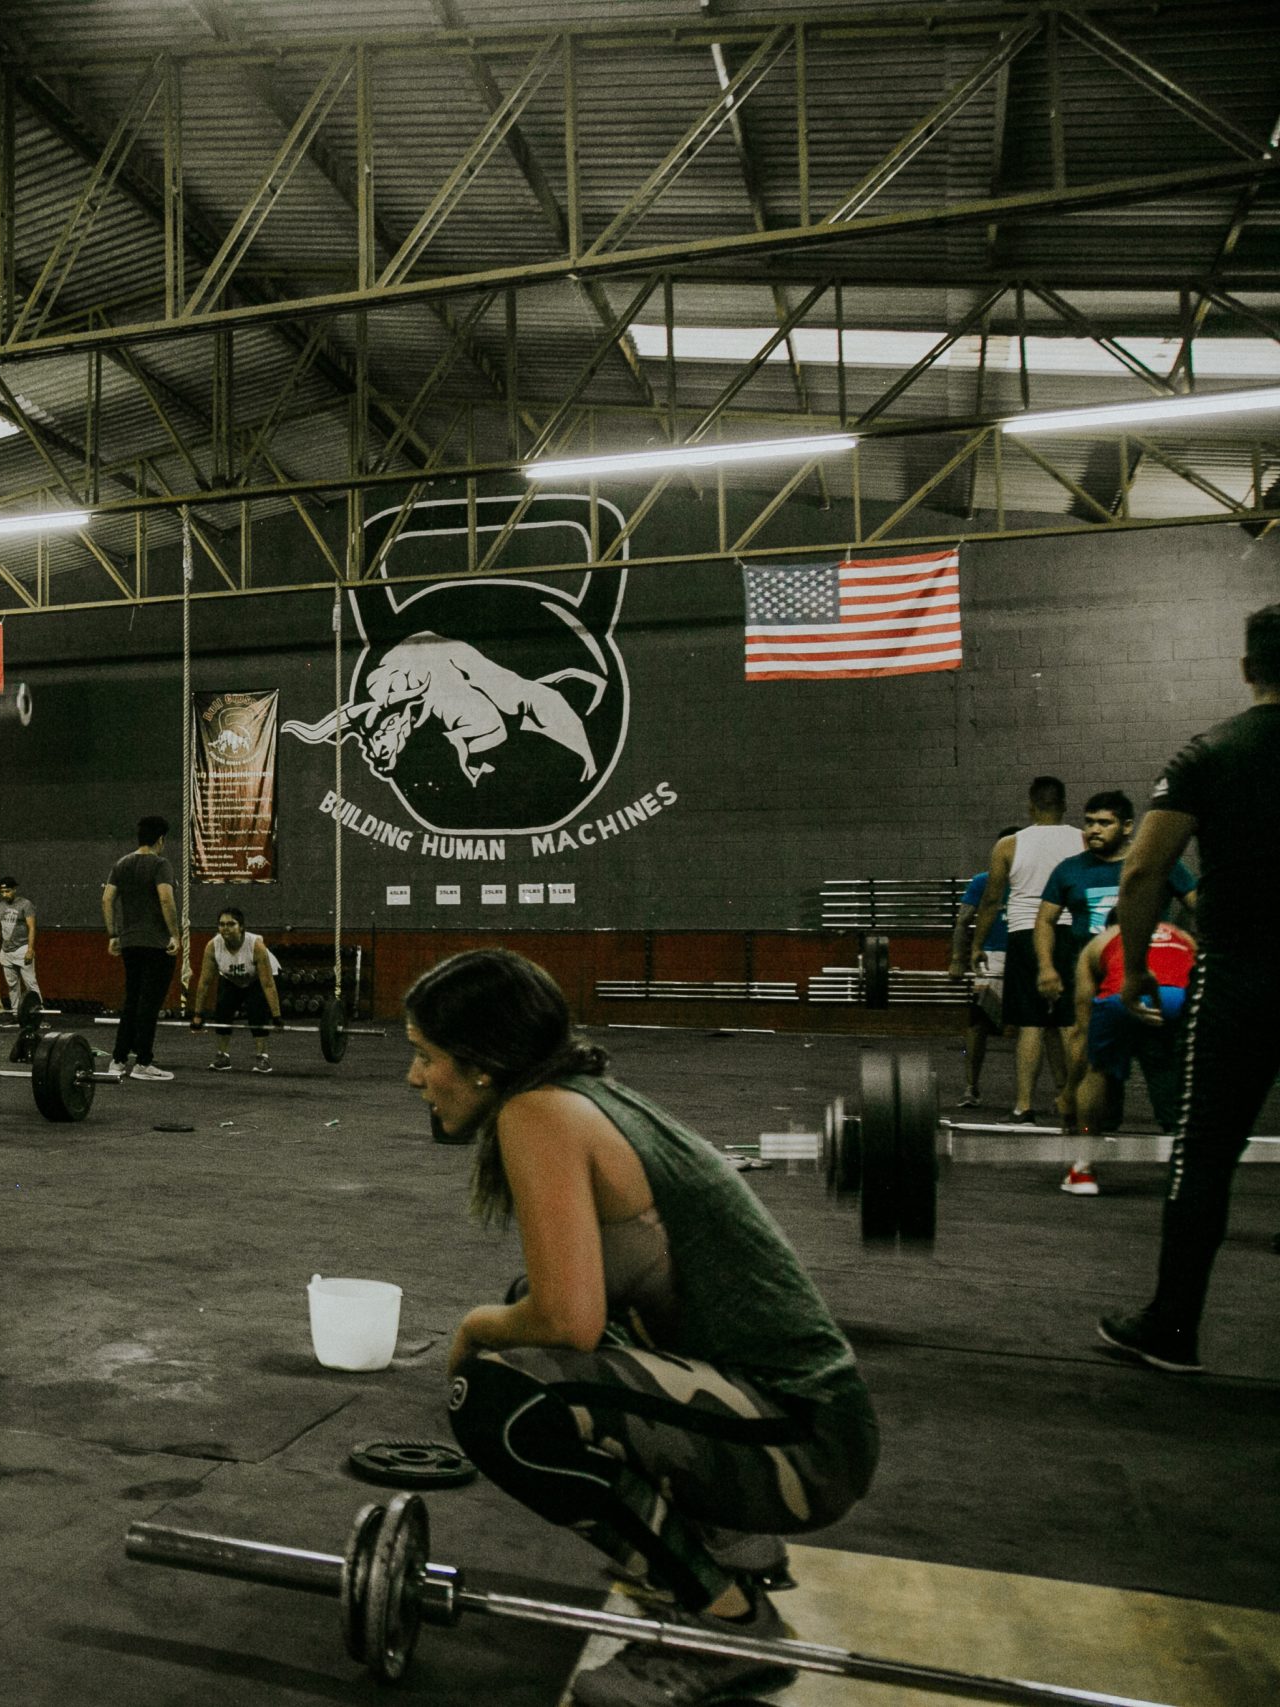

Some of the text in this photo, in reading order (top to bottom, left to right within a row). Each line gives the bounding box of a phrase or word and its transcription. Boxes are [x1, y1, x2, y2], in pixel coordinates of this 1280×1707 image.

[318, 781, 679, 861] BUILDING HUMAN MACHINES
